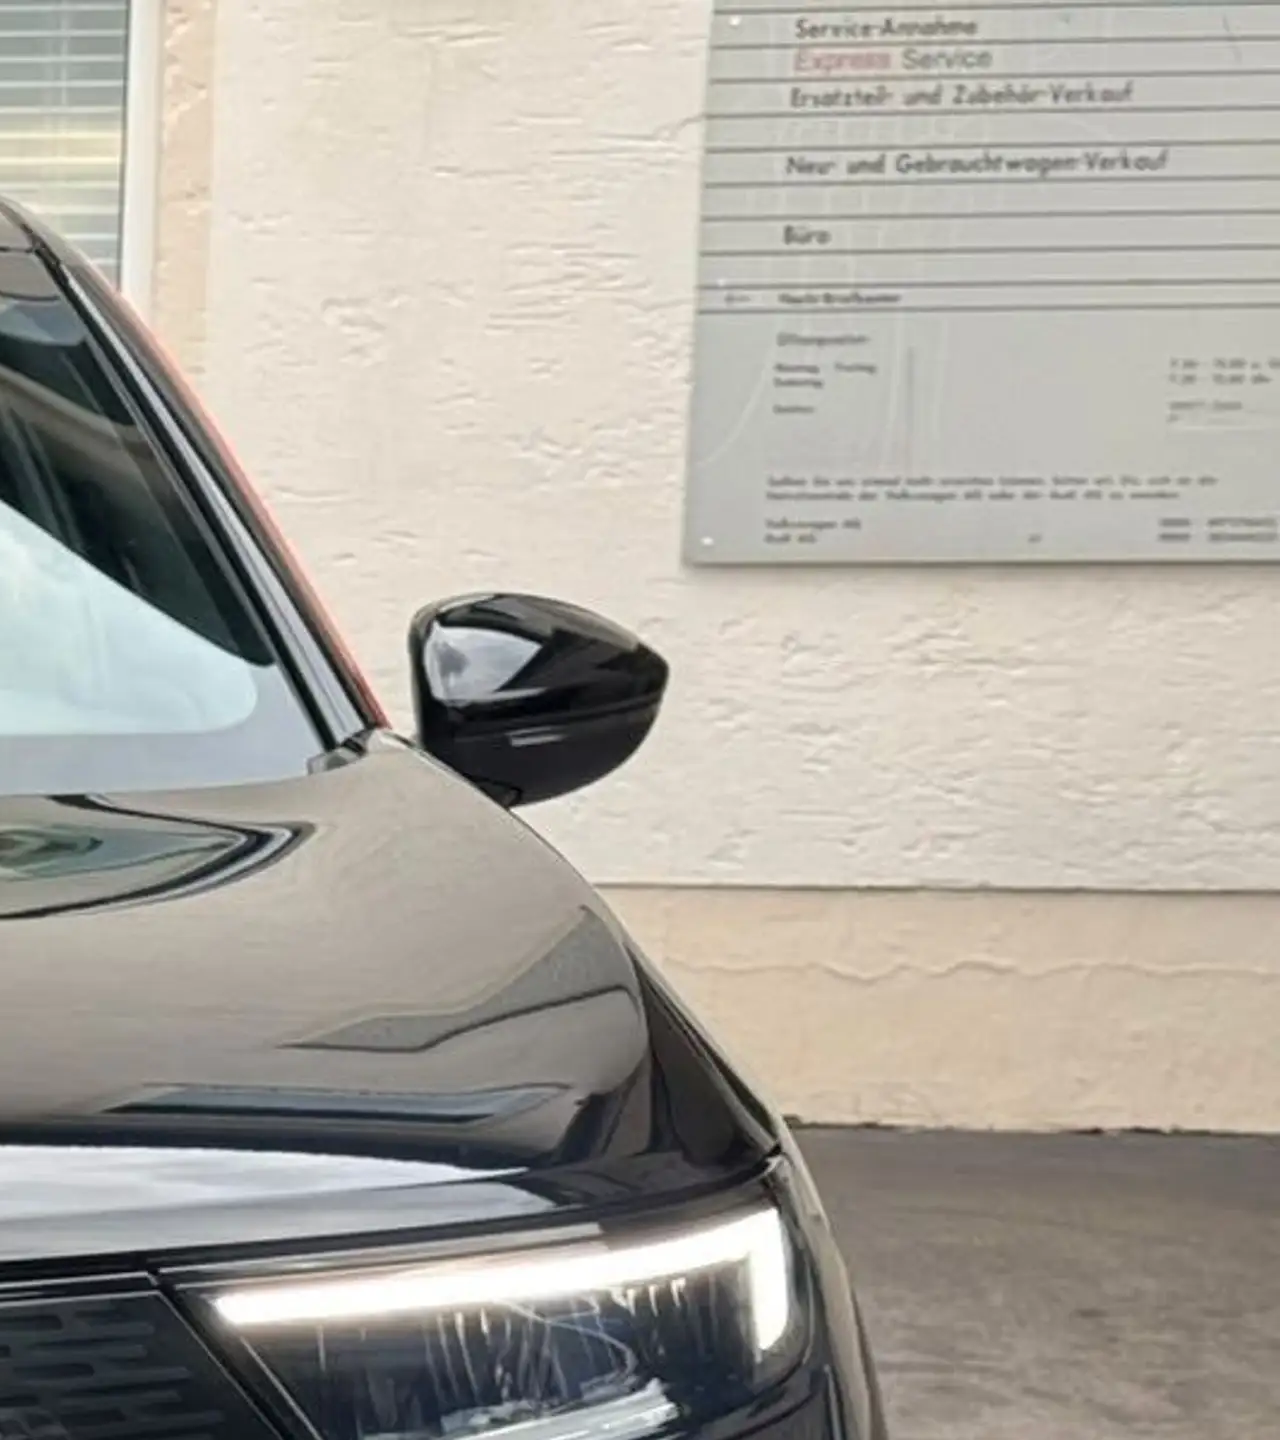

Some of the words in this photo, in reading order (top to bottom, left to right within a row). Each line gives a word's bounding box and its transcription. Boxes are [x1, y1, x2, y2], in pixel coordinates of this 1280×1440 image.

[901, 49, 994, 70] Service
[901, 83, 943, 105] und
[845, 152, 887, 174] und
